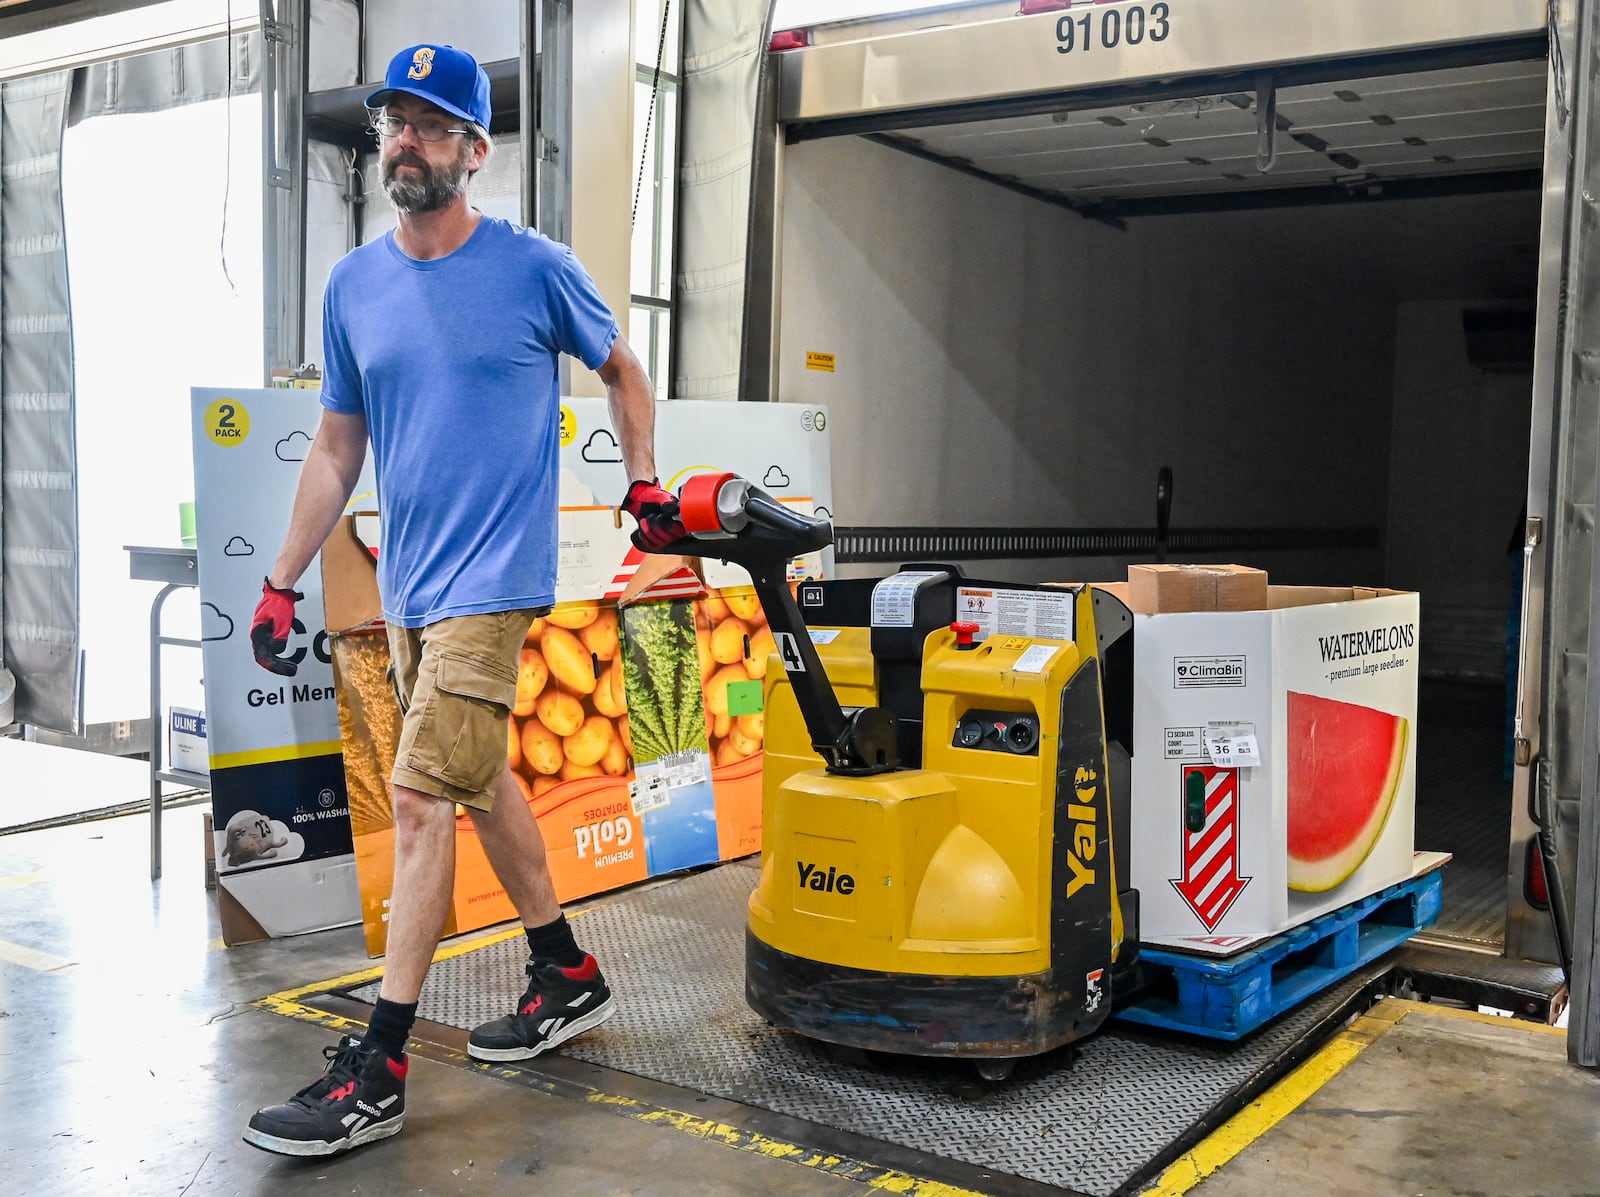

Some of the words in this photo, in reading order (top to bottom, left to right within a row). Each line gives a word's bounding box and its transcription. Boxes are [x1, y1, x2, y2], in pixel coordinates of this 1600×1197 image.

[219, 405, 235, 427] 2
[215, 429, 241, 437] PACK
[783, 634, 800, 669] 4
[1318, 623, 1414, 663] WATERMELONS
[1189, 665, 1242, 676] ClimaBin
[1330, 666, 1361, 683] premium
[1362, 659, 1379, 676] large
[1380, 653, 1405, 671] seedless
[247, 686, 285, 707] Gel
[174, 715, 197, 732] ULINE
[1214, 745, 1230, 755] 36
[292, 813, 315, 824] 100%
[316, 808, 350, 820] WASHA
[583, 801, 628, 821] POTATOES
[572, 816, 632, 859] Gold
[595, 848, 634, 869] PREMIUM
[797, 861, 855, 895] Yale
